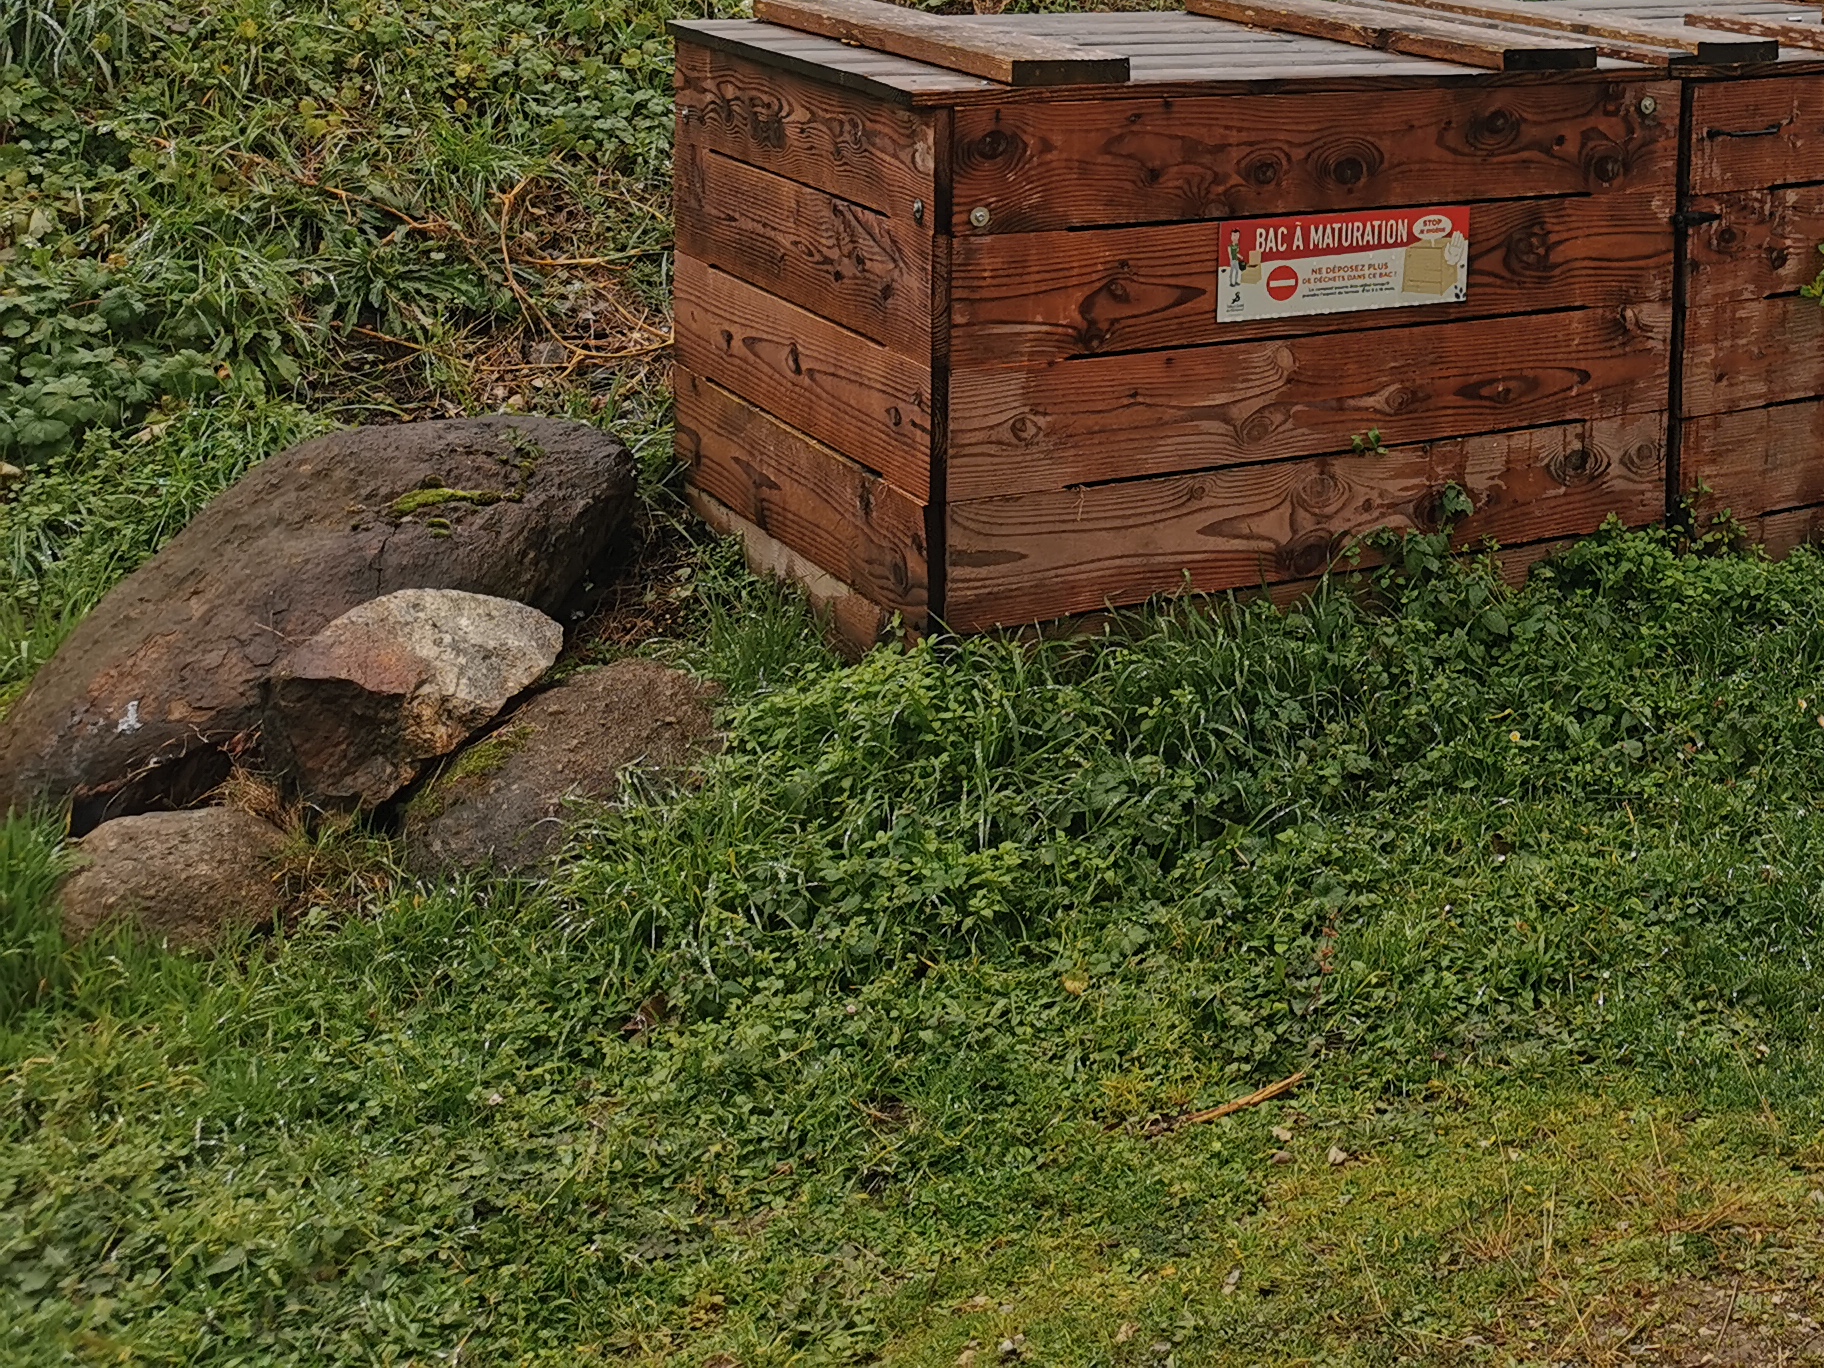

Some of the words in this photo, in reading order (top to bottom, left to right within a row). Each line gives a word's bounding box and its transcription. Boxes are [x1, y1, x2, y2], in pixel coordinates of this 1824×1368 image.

[1423, 218, 1442, 227] STOP
[1256, 226, 1288, 253] BAC
[1293, 221, 1304, 251] À
[1309, 219, 1409, 250] MATURATION
[1311, 267, 1323, 275] NE
[1325, 264, 1365, 274] DÉPOSEZ
[1367, 262, 1389, 271] PLUS
[1313, 275, 1345, 284] DÉCHETS
[1347, 273, 1366, 281] DANS
[1379, 271, 1393, 279] BAC
